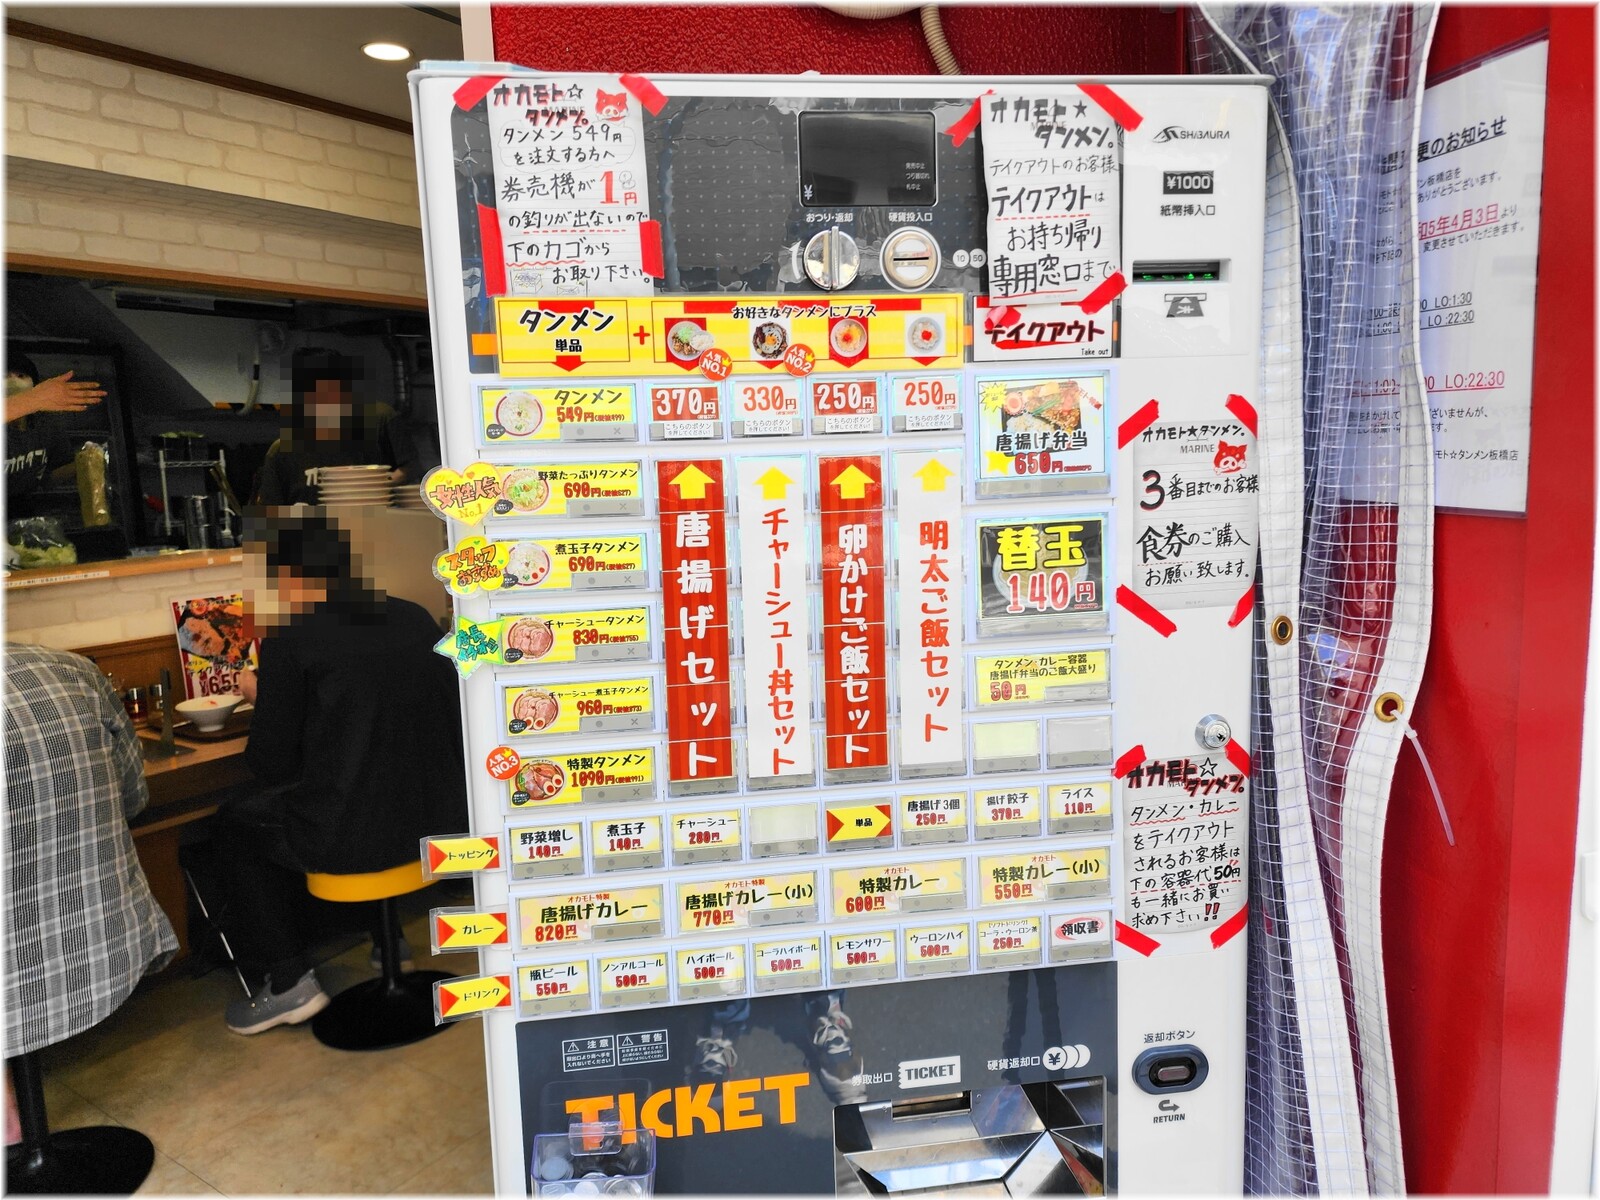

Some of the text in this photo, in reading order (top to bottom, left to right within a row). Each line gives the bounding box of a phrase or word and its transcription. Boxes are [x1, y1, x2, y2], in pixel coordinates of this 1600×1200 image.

[1180, 130, 1230, 139] SHIBAURA
[513, 147, 615, 165] を注文する方へ
[989, 155, 1120, 177] テイクアウトのお客様
[1167, 175, 1211, 189] ¥1000
[991, 183, 1105, 217] テイクアウトは
[508, 209, 648, 229] の釣りが出ないので
[806, 213, 854, 223] おつり・返却
[888, 212, 933, 222] 硬貨投入口
[1160, 204, 1216, 217] 紙幣挿入口
[1007, 219, 1102, 251] お持ち帰り
[506, 237, 610, 263] 下のカゴから
[552, 265, 651, 286] お取り下さい。
[990, 254, 1116, 298] 専用窓口まで
[731, 304, 877, 319] お好きなタンメンにプラス
[518, 309, 615, 333] タンメン
[984, 320, 1105, 345] テイクアウト
[555, 339, 582, 353] 単品
[701, 358, 727, 377] NO.1
[785, 353, 812, 373] NO.2
[554, 388, 623, 406] タンメン
[656, 388, 717, 416] 370円
[743, 385, 797, 412] 330円
[816, 383, 875, 410] 250円
[903, 381, 956, 407] 250円
[666, 422, 712, 431] こちらのボタン
[746, 418, 791, 427] こちらのボタン
[827, 417, 872, 425] こちらのボタン
[908, 414, 952, 423] こちらのボタン
[996, 430, 1089, 452] 唐揚げ弁当
[1180, 444, 1215, 454] MARINE
[1014, 451, 1064, 475] 650円
[538, 468, 638, 481] 野菜たっぷりタンメン
[429, 476, 502, 510] 女性人気
[1140, 470, 1260, 511] 3番目までのお客様
[555, 541, 640, 556] 煮玉子タンメン
[997, 525, 1087, 571] 替玉
[1136, 522, 1251, 564] 食券のご購入
[445, 544, 497, 571] スタッフ
[456, 562, 501, 587] おすすめ
[1145, 559, 1250, 587] お願い致します。
[1007, 573, 1096, 613] 140円
[545, 615, 645, 629] チャーシュータンメン
[919, 520, 950, 743] 明太ご飯セット
[676, 512, 718, 777] 唐揚げセット
[762, 507, 796, 776] チャーシュー丼セット
[838, 524, 870, 764] 卵かけご飯セット
[990, 664, 1097, 681] 唐揚げ弁当のご飯大盛り
[549, 685, 649, 699] チャーシュー煮玉子タンメン
[990, 681, 1027, 701] 50円
[490, 756, 519, 777] NO.3
[566, 754, 647, 771] 特製タンメン
[1061, 786, 1094, 800] ライス
[606, 822, 647, 837] 煮玉子
[676, 817, 738, 830] チャーシュー
[855, 817, 873, 828] 単品
[520, 829, 574, 845] 野菜増し
[1133, 821, 1234, 850] をテイクアウト
[449, 848, 495, 861] トッピング
[1134, 843, 1240, 871] されるお客様は
[992, 858, 1101, 882] 特製カレー(小)
[1130, 865, 1241, 891] 下の容器代50円
[859, 875, 940, 894] 特製カレー
[994, 883, 1032, 900] 550円
[685, 884, 814, 911] 唐揚げカレー(小)
[845, 895, 885, 913] 600円
[1131, 883, 1230, 909] も一緒にお買い
[541, 901, 648, 924] 唐揚げカレー
[693, 909, 734, 928] 770円
[462, 924, 494, 935] カレー
[534, 924, 577, 942] 820円
[909, 930, 964, 944] ウーロンハイ
[1060, 920, 1099, 936] 領収書
[756, 943, 819, 958] コーラハイボール
[836, 937, 891, 951] レモンサワー
[603, 958, 664, 972] ノンアルコール
[686, 951, 735, 965] ハイボール
[530, 965, 578, 981] 瓶ビール
[464, 987, 501, 1002] ドリンク
[587, 1038, 609, 1049] 注意
[1143, 1029, 1196, 1044] 返却ボタン
[905, 1063, 956, 1081] TICKET
[987, 1055, 1041, 1071] 硬貨返却口
[565, 1072, 810, 1151] TICKET
[1152, 1113, 1186, 1124] RETURN
